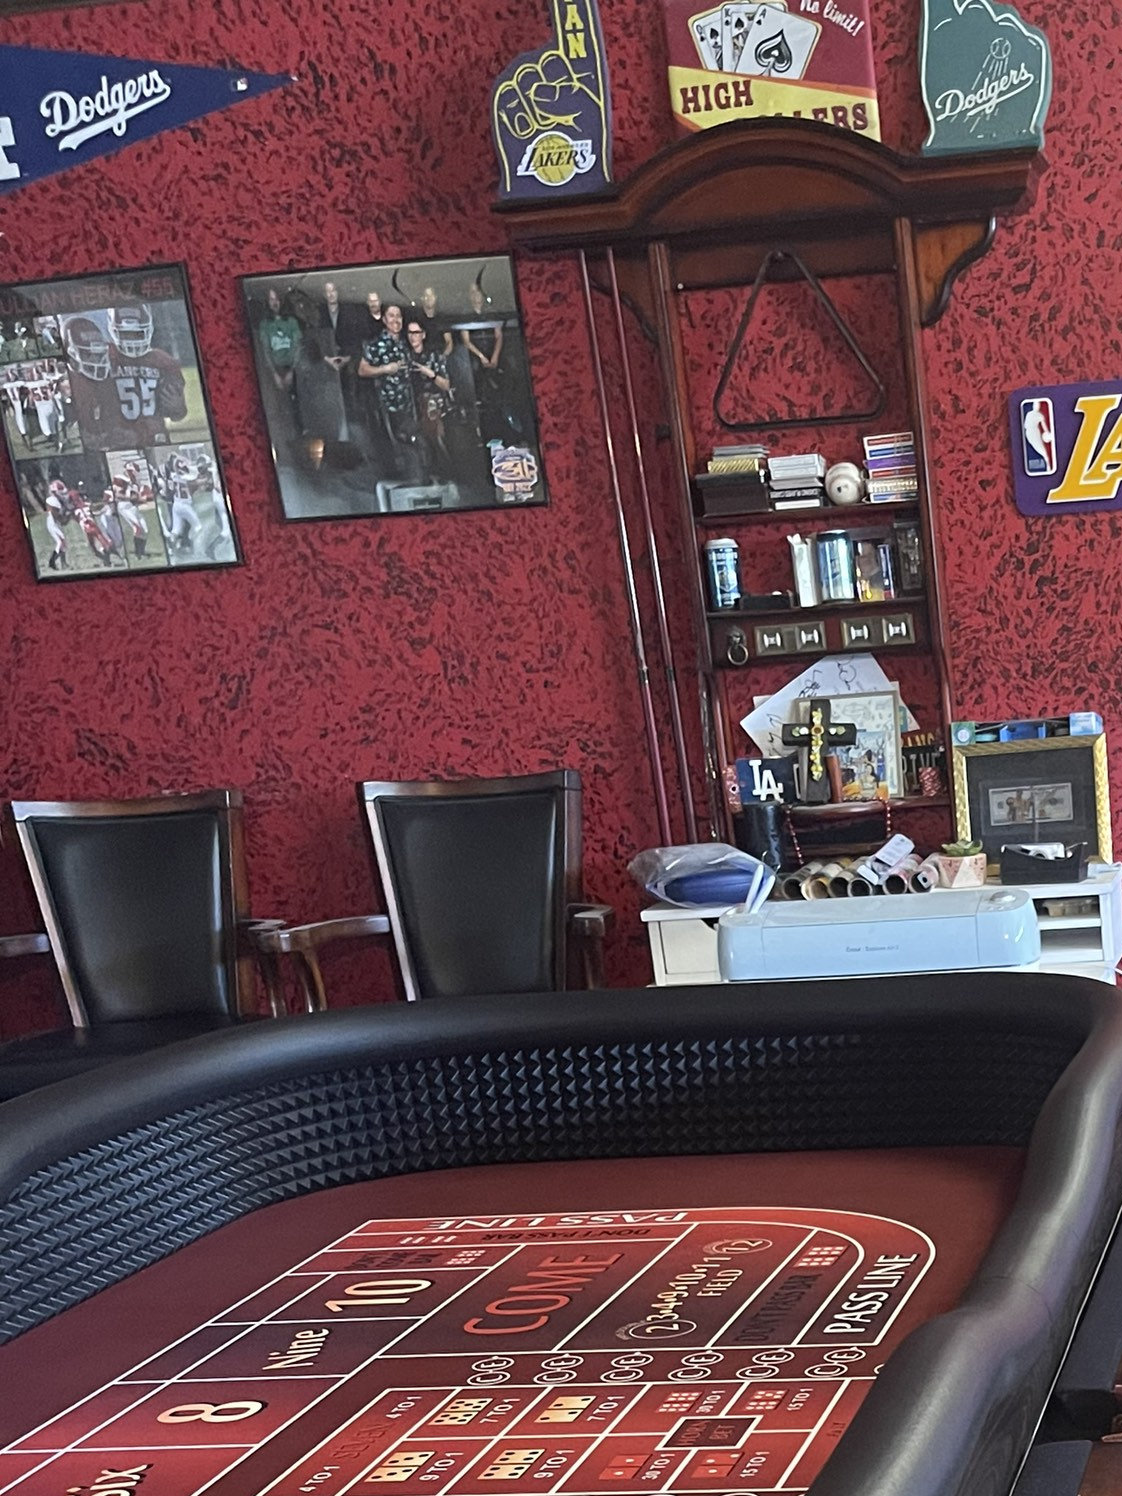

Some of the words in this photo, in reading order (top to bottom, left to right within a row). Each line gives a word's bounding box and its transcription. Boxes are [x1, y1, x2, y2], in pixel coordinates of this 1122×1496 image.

[564, 0, 588, 59] AN
[823, 3, 865, 37] limit!
[680, 80, 754, 114] HIGH
[935, 62, 1034, 121] Dodgers
[40, 69, 171, 151] Dodgers
[522, 147, 596, 175] LAKERS
[115, 377, 157, 421] 55
[425, 1217, 546, 1231] LINE
[554, 1212, 689, 1226] PASS
[325, 1279, 433, 1313] 10
[464, 1253, 624, 1335] COME
[697, 1269, 743, 1297] FIELD
[823, 1292, 890, 1334] PASS
[857, 1254, 918, 1289] LINE
[262, 1328, 330, 1370] Nine
[157, 1401, 265, 1424] 8
